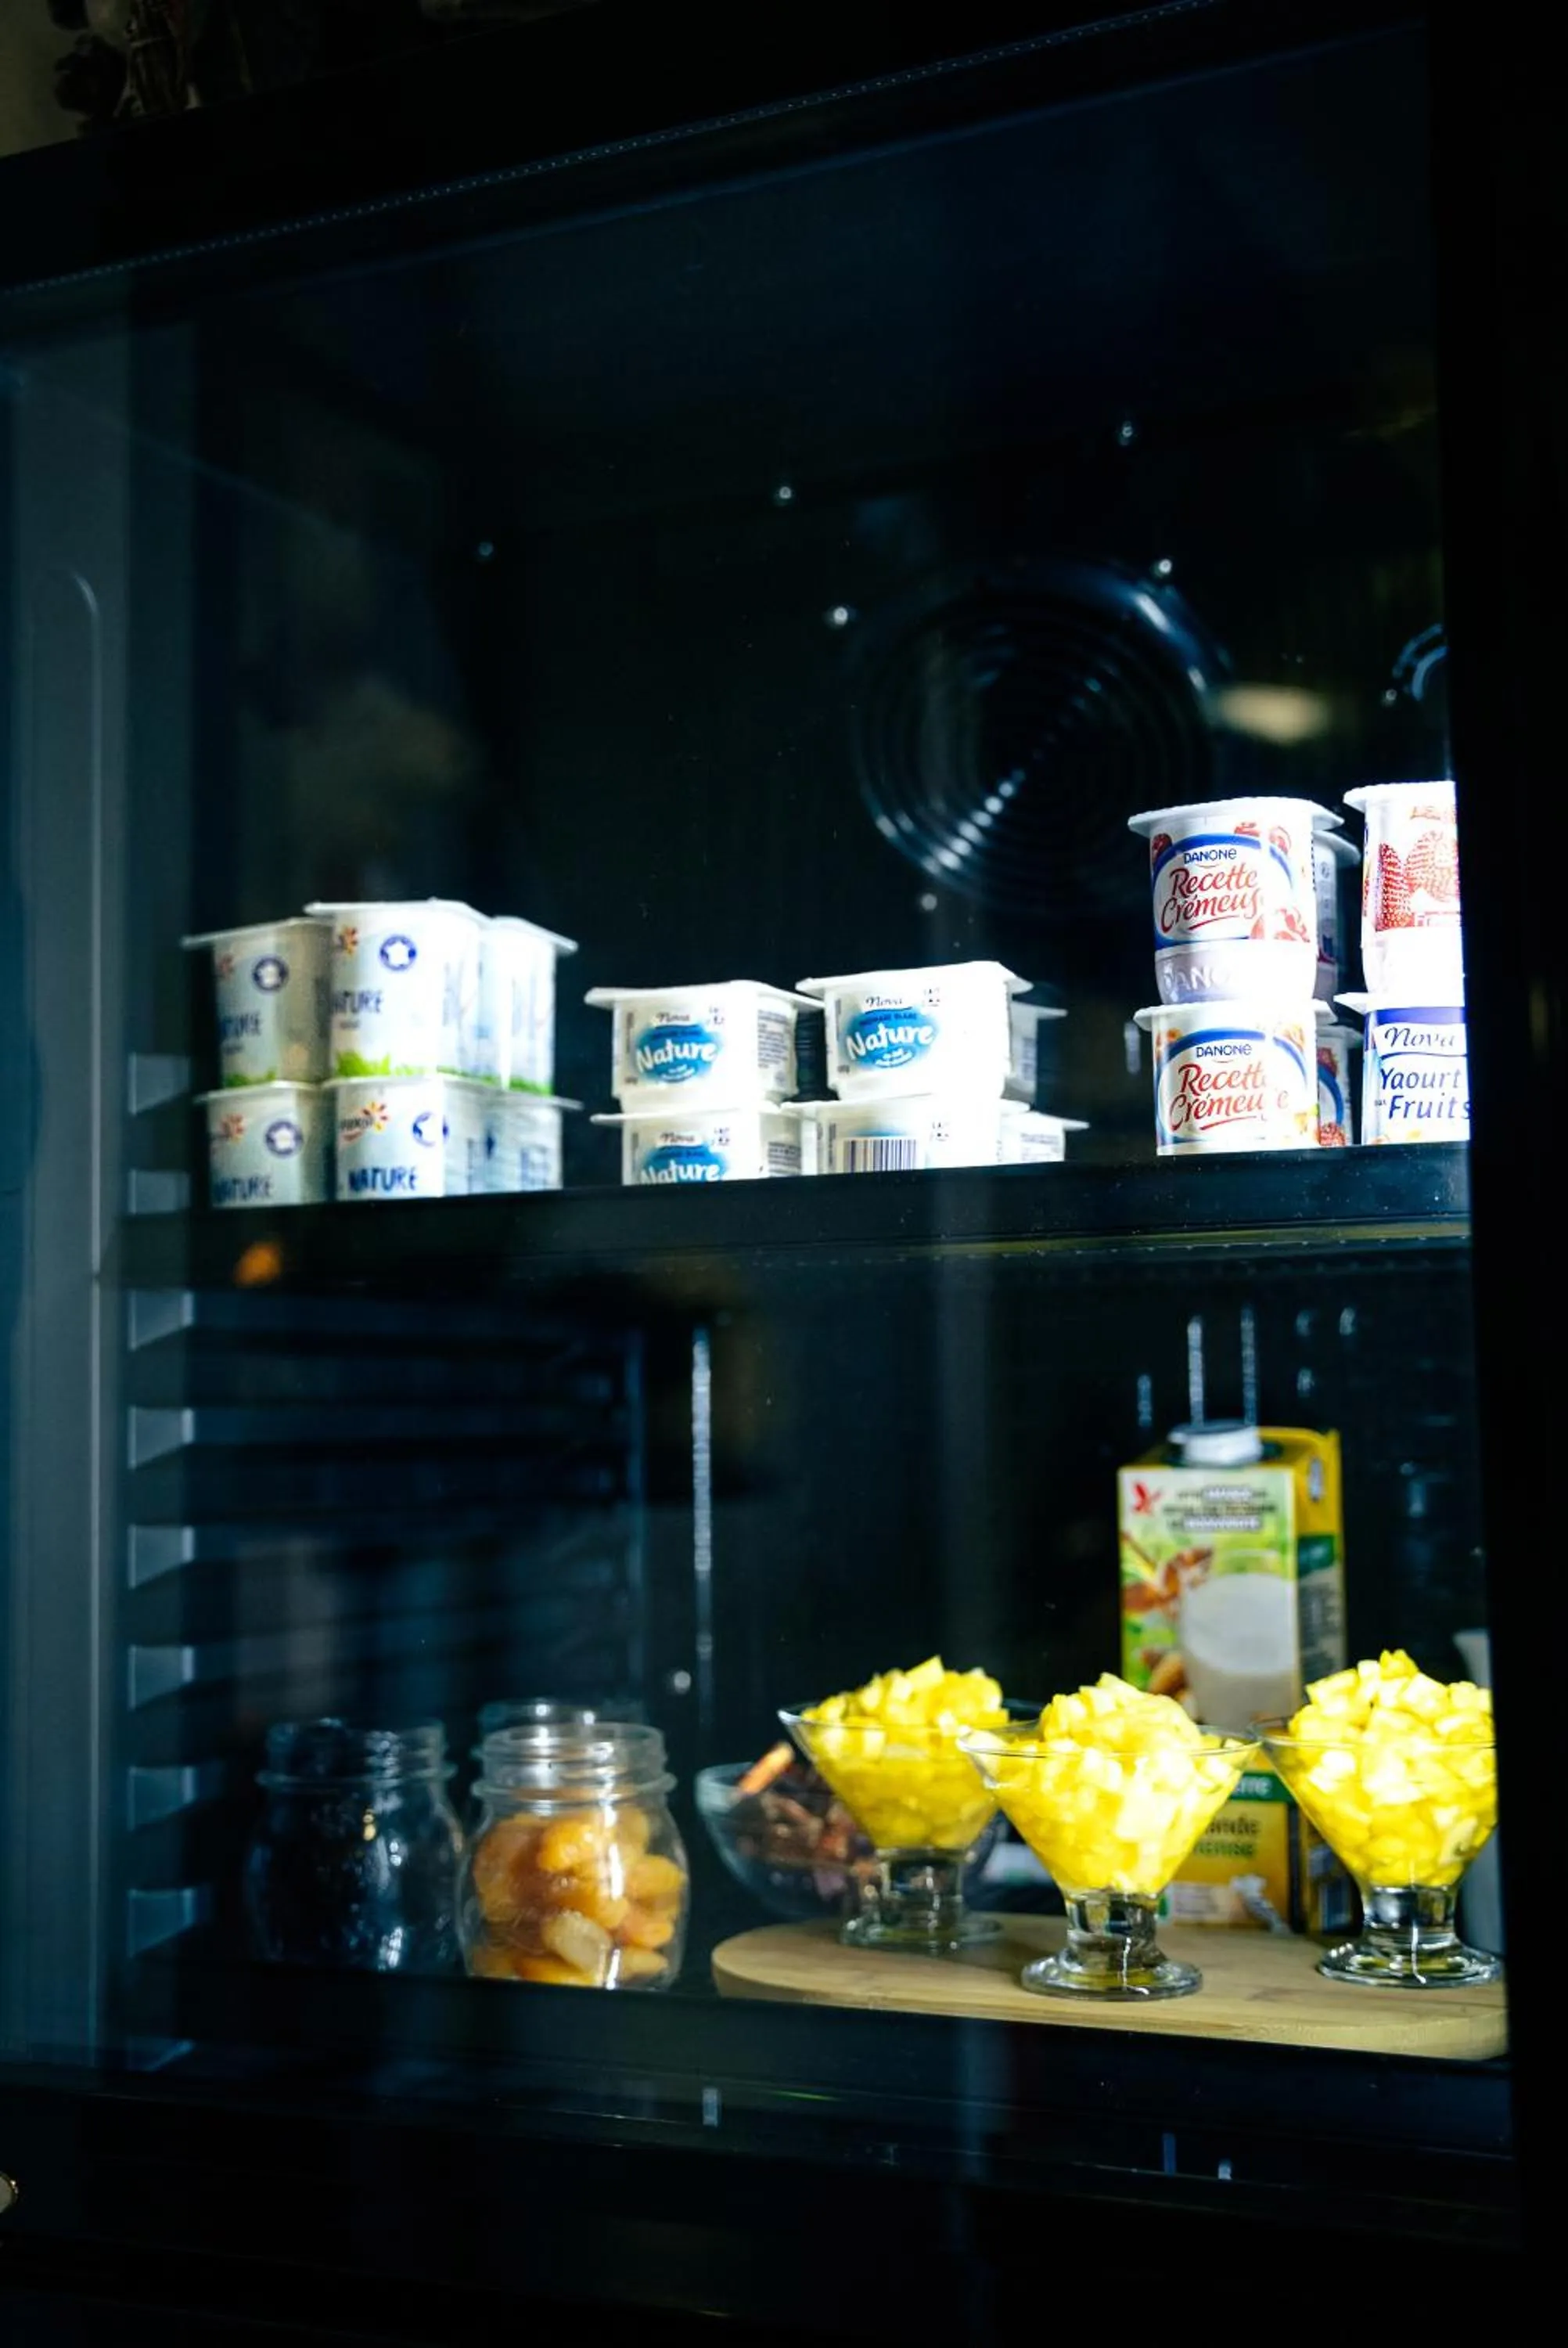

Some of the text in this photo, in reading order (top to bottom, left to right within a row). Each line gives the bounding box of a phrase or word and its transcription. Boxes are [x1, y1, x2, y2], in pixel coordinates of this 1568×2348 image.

[1184, 848, 1237, 865] DANONE
[1169, 862, 1258, 899] Recette
[1161, 888, 1263, 933] Crémeus
[847, 1023, 934, 1060] Nature
[1384, 1026, 1455, 1047] Nova
[635, 1039, 717, 1073] Nature
[1196, 1043, 1253, 1058] DANONE
[1380, 1067, 1462, 1090] Yaourt
[1169, 1089, 1289, 1132] Crémeue
[1388, 1094, 1472, 1120] Fruits
[348, 1166, 418, 1192] NATURE
[641, 1159, 721, 1184] Nature
